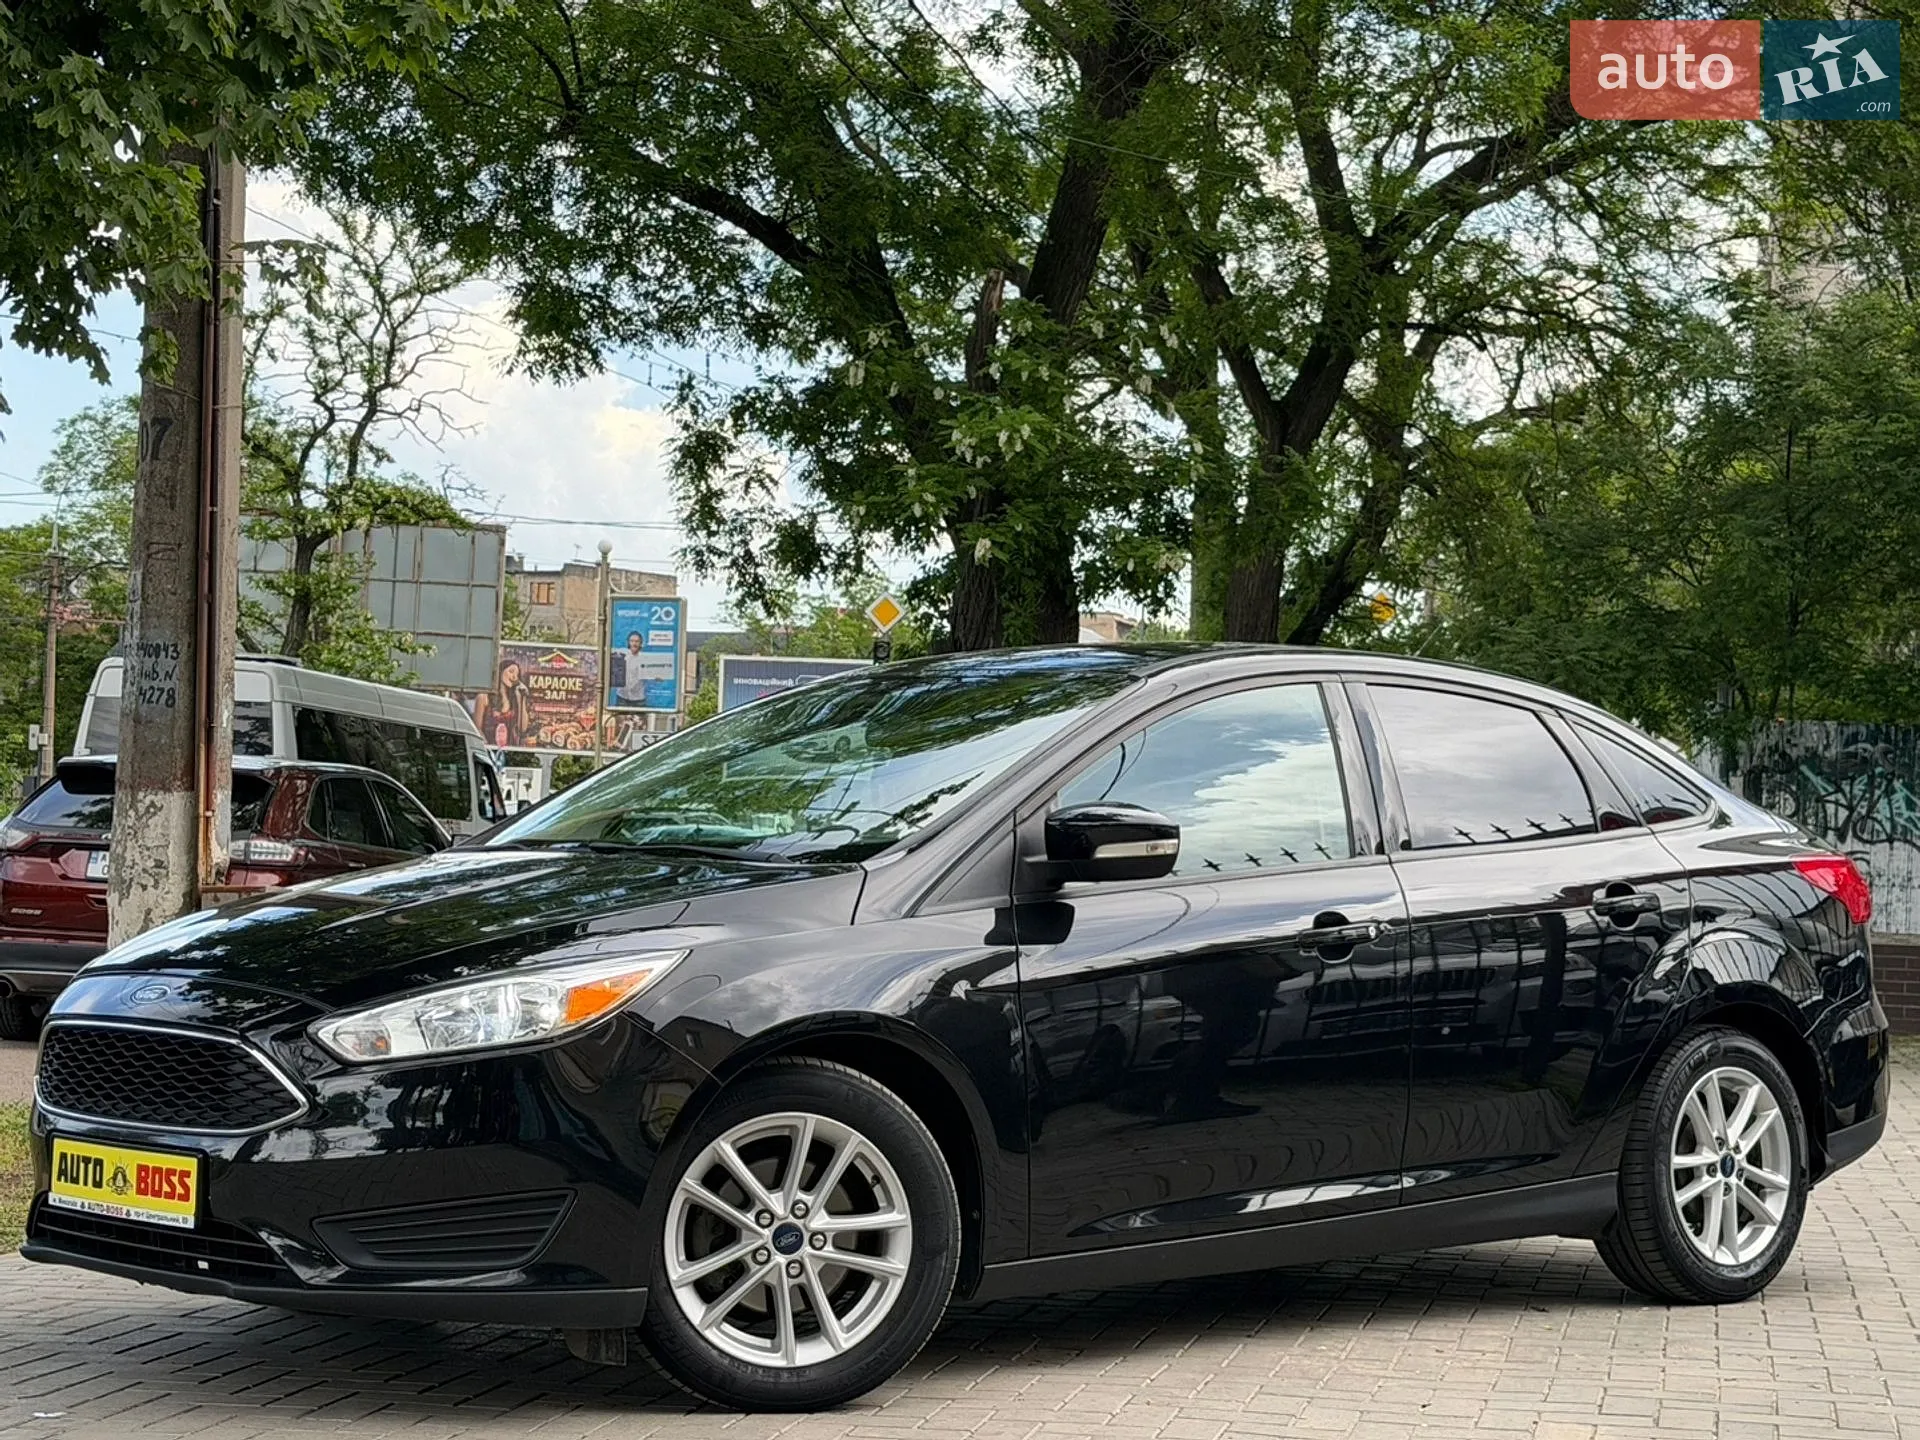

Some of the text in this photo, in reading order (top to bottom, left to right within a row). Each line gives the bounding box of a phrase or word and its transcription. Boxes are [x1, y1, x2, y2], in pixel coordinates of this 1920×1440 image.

[650, 606, 676, 622] 20
[529, 674, 584, 691] КАРАОКЕ
[139, 686, 176, 708] 4278
[544, 689, 567, 700] ЗАЛ
[57, 1151, 191, 1202] AUTO BOSS
